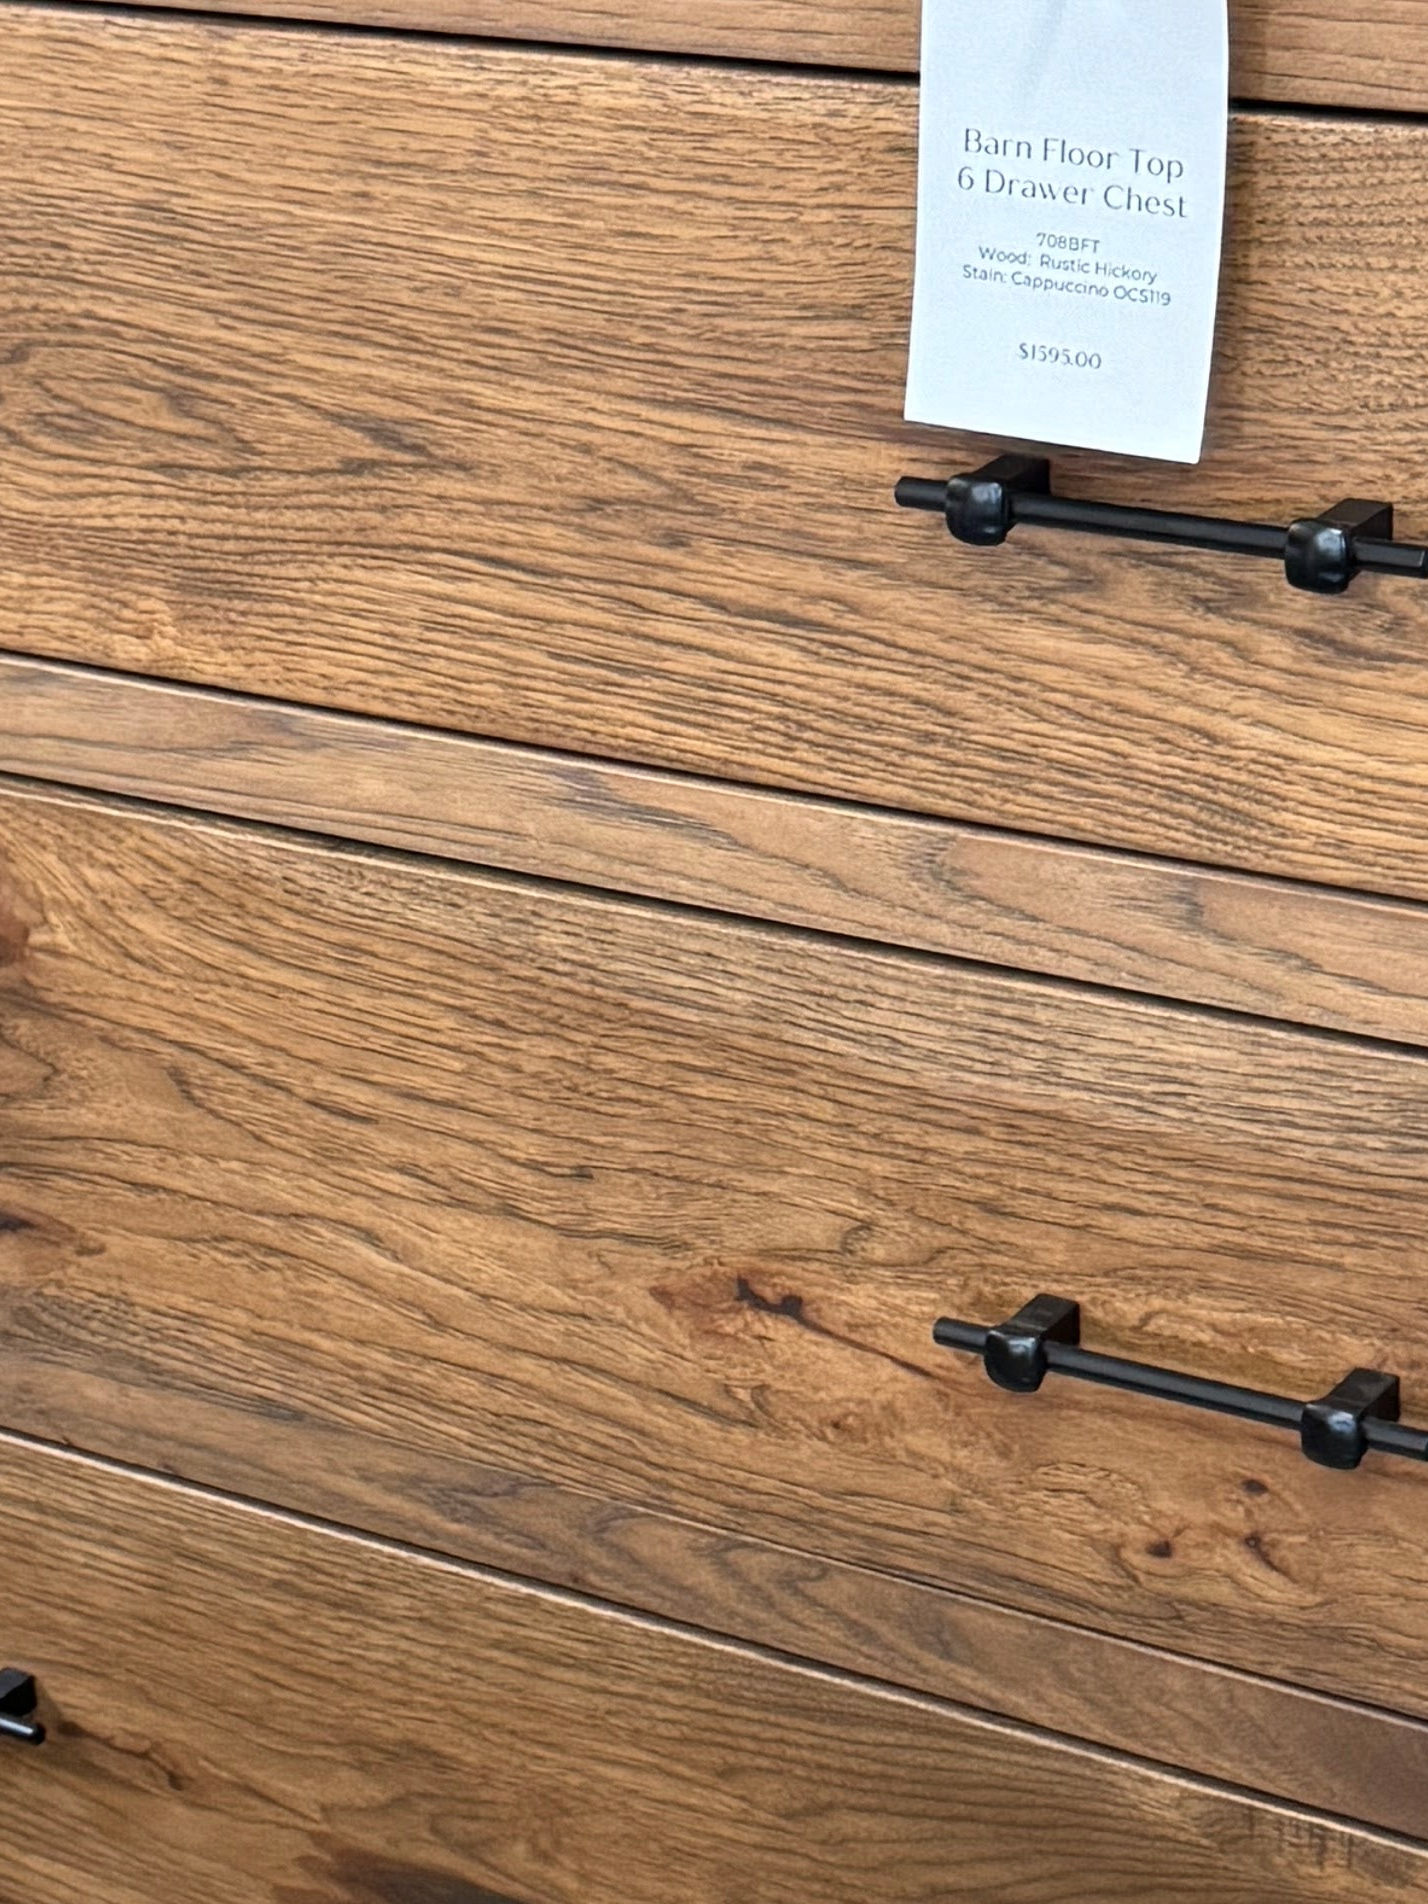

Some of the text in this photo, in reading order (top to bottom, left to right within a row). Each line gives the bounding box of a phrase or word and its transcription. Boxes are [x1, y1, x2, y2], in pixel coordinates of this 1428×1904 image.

[964, 127, 1185, 184] Barn Floor Top
[957, 165, 1188, 218] 6 Drawer Chest
[1036, 232, 1100, 254] 708BFT
[962, 263, 1172, 307] Stain: Cappuccino OCS119
[978, 245, 1158, 286] Wood: Rustic Hickory
[1017, 341, 1102, 370] $1595.00
